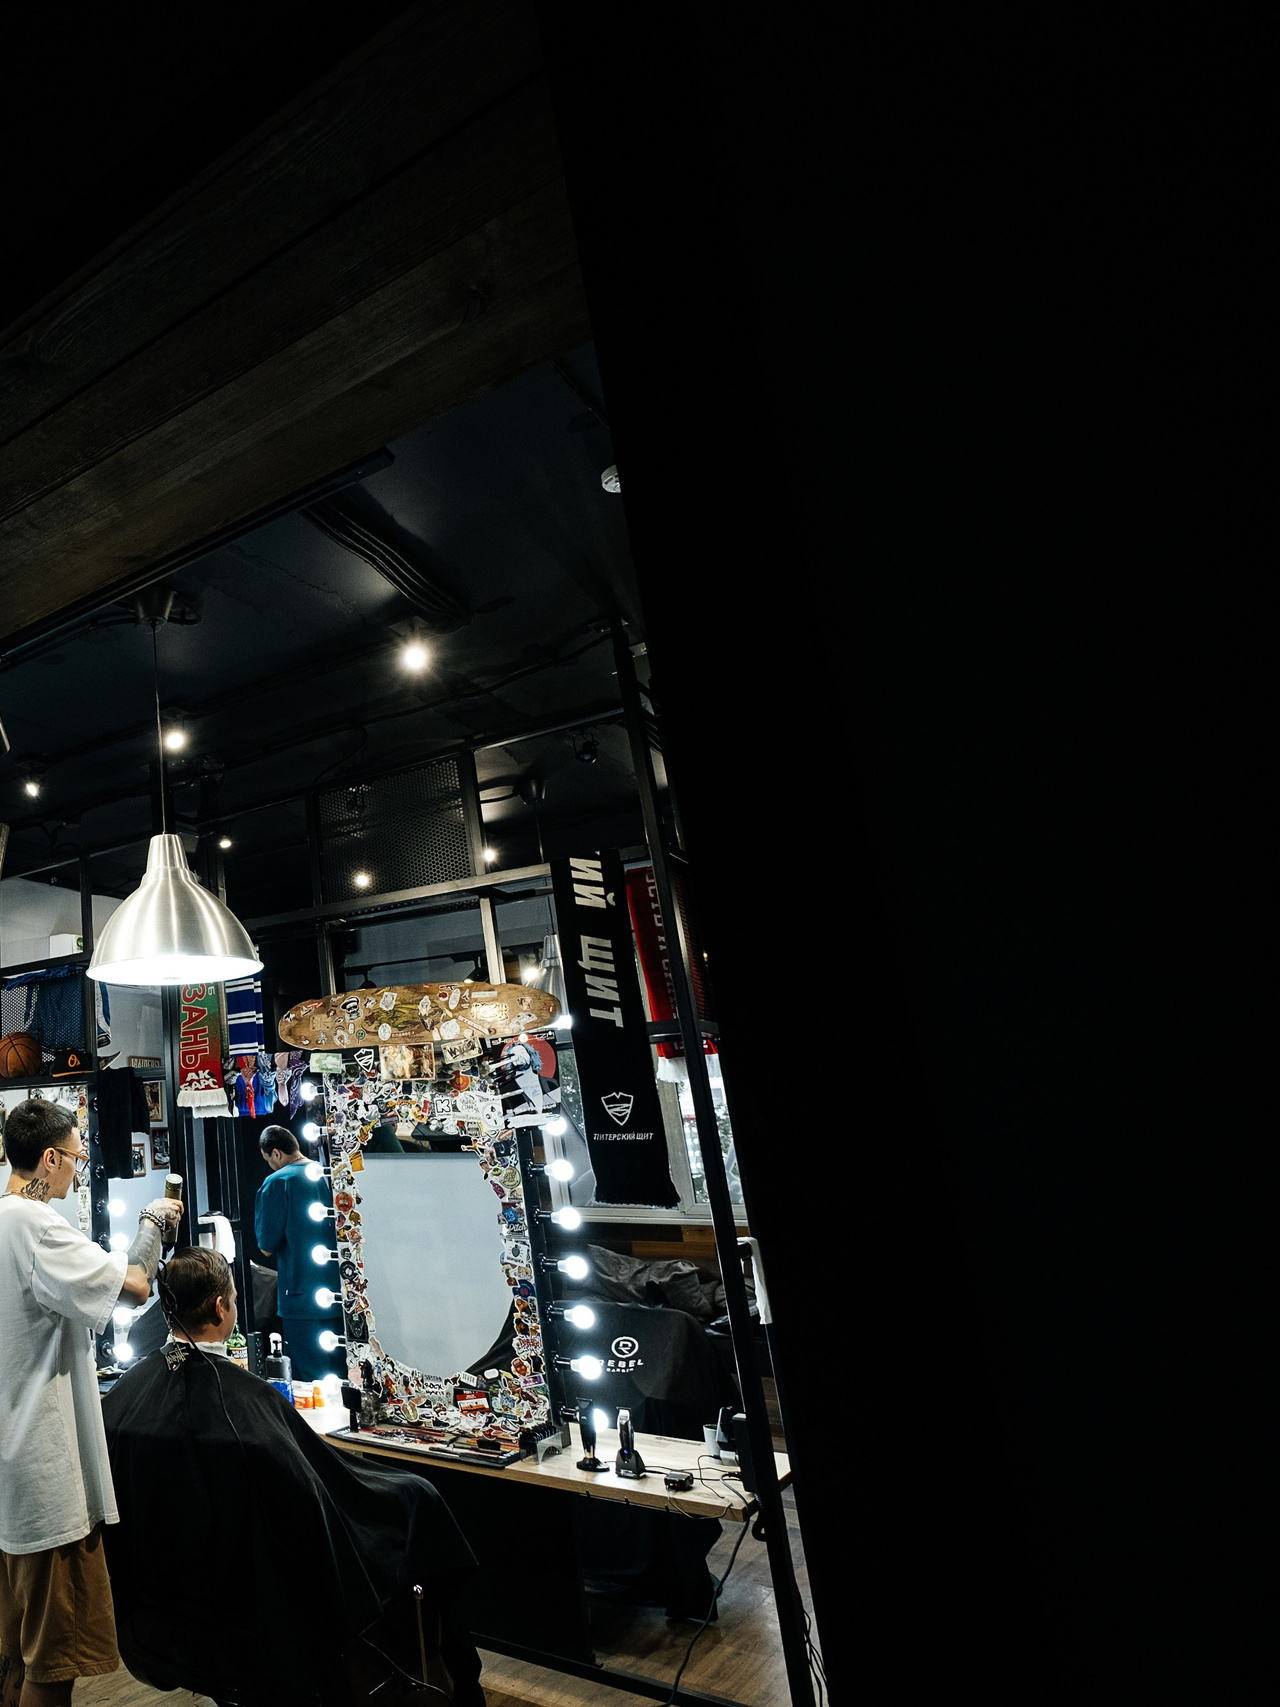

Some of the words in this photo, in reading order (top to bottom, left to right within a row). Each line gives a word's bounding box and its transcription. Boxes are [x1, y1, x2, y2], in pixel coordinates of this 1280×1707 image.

[570, 851, 616, 909] ИЙ
[577, 934, 625, 1028] ЩИТ
[593, 1131, 635, 1141] ПИТЕРСКИЙ
[636, 1132, 654, 1141] ЩИТ
